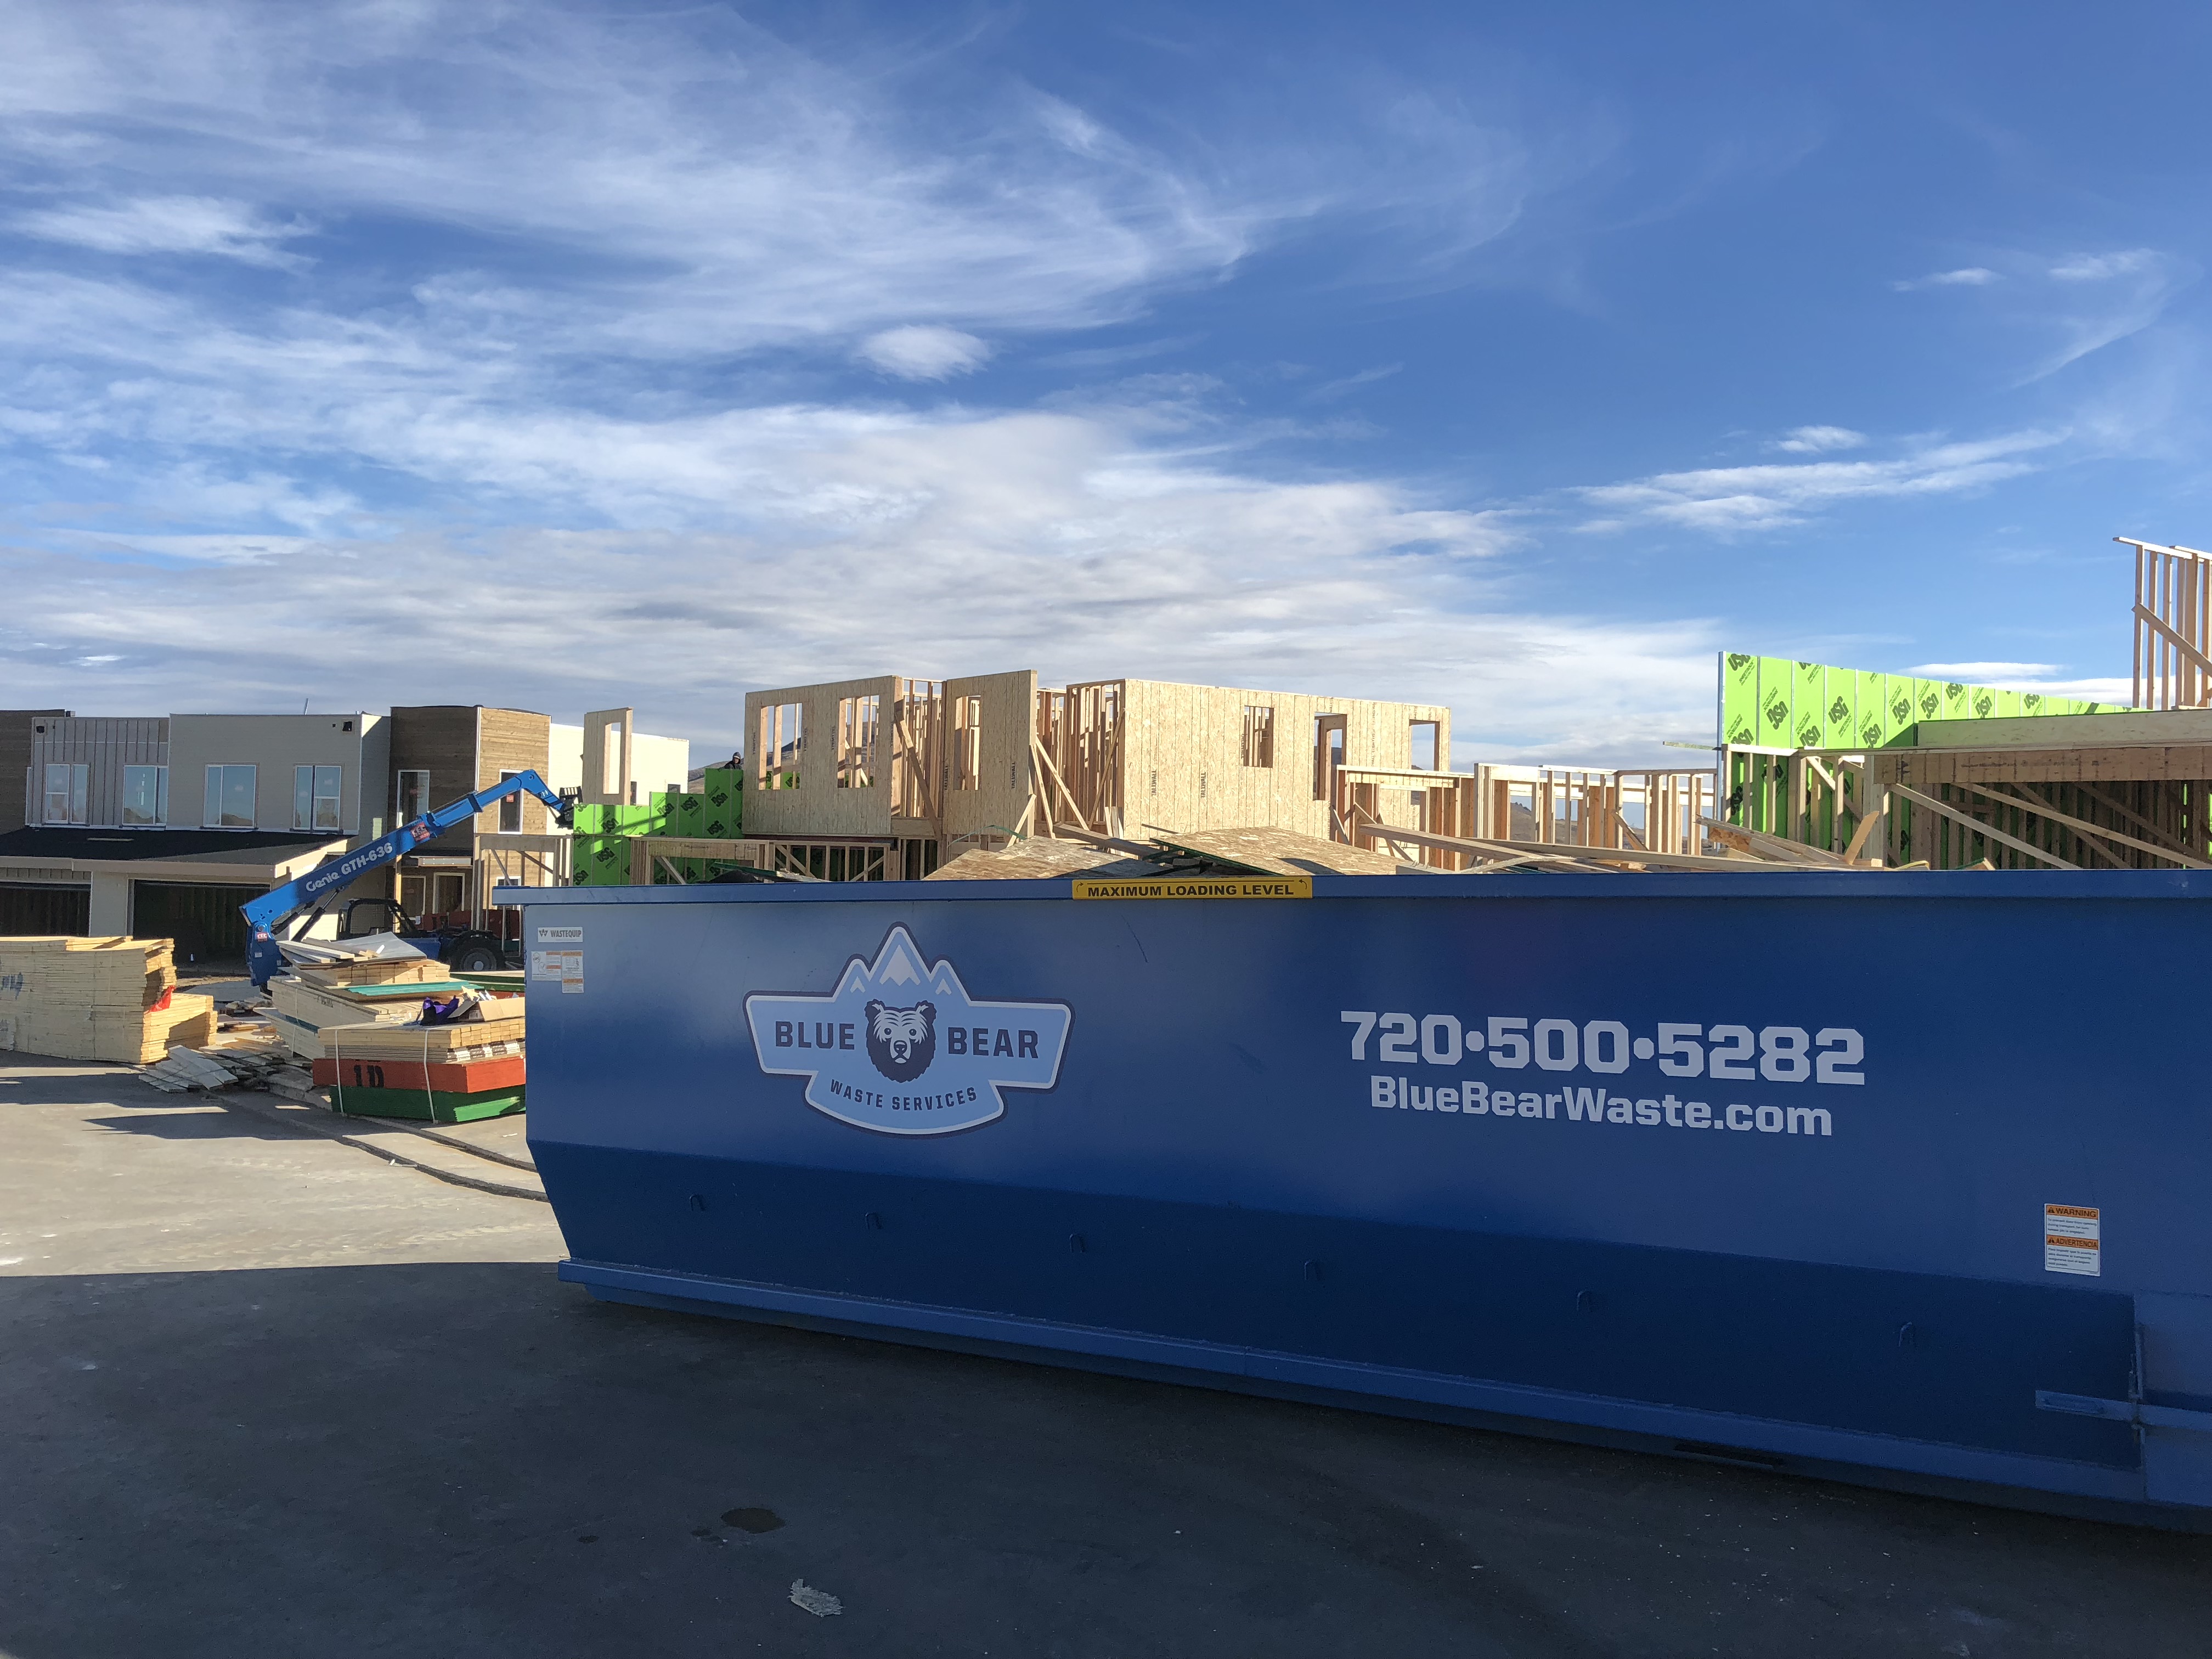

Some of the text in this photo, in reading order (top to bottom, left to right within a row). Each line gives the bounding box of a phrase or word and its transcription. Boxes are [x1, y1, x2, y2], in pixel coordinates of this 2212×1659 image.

[1767, 701, 1789, 730] USG
[1828, 696, 1849, 724] USG
[1892, 698, 1911, 725] USG
[306, 842, 393, 891] Genie GTH-636
[1088, 884, 1294, 897] MAXIMUM LOADING LEVEL
[775, 1021, 1039, 1059] BLUE BEAR
[831, 1079, 977, 1111] WASTE SERVICES
[1371, 1075, 1832, 1136] BlueBearWaste.com
[2056, 1207, 2096, 1217] WARNING
[2056, 1238, 2097, 1247] ADVERTENCIA
